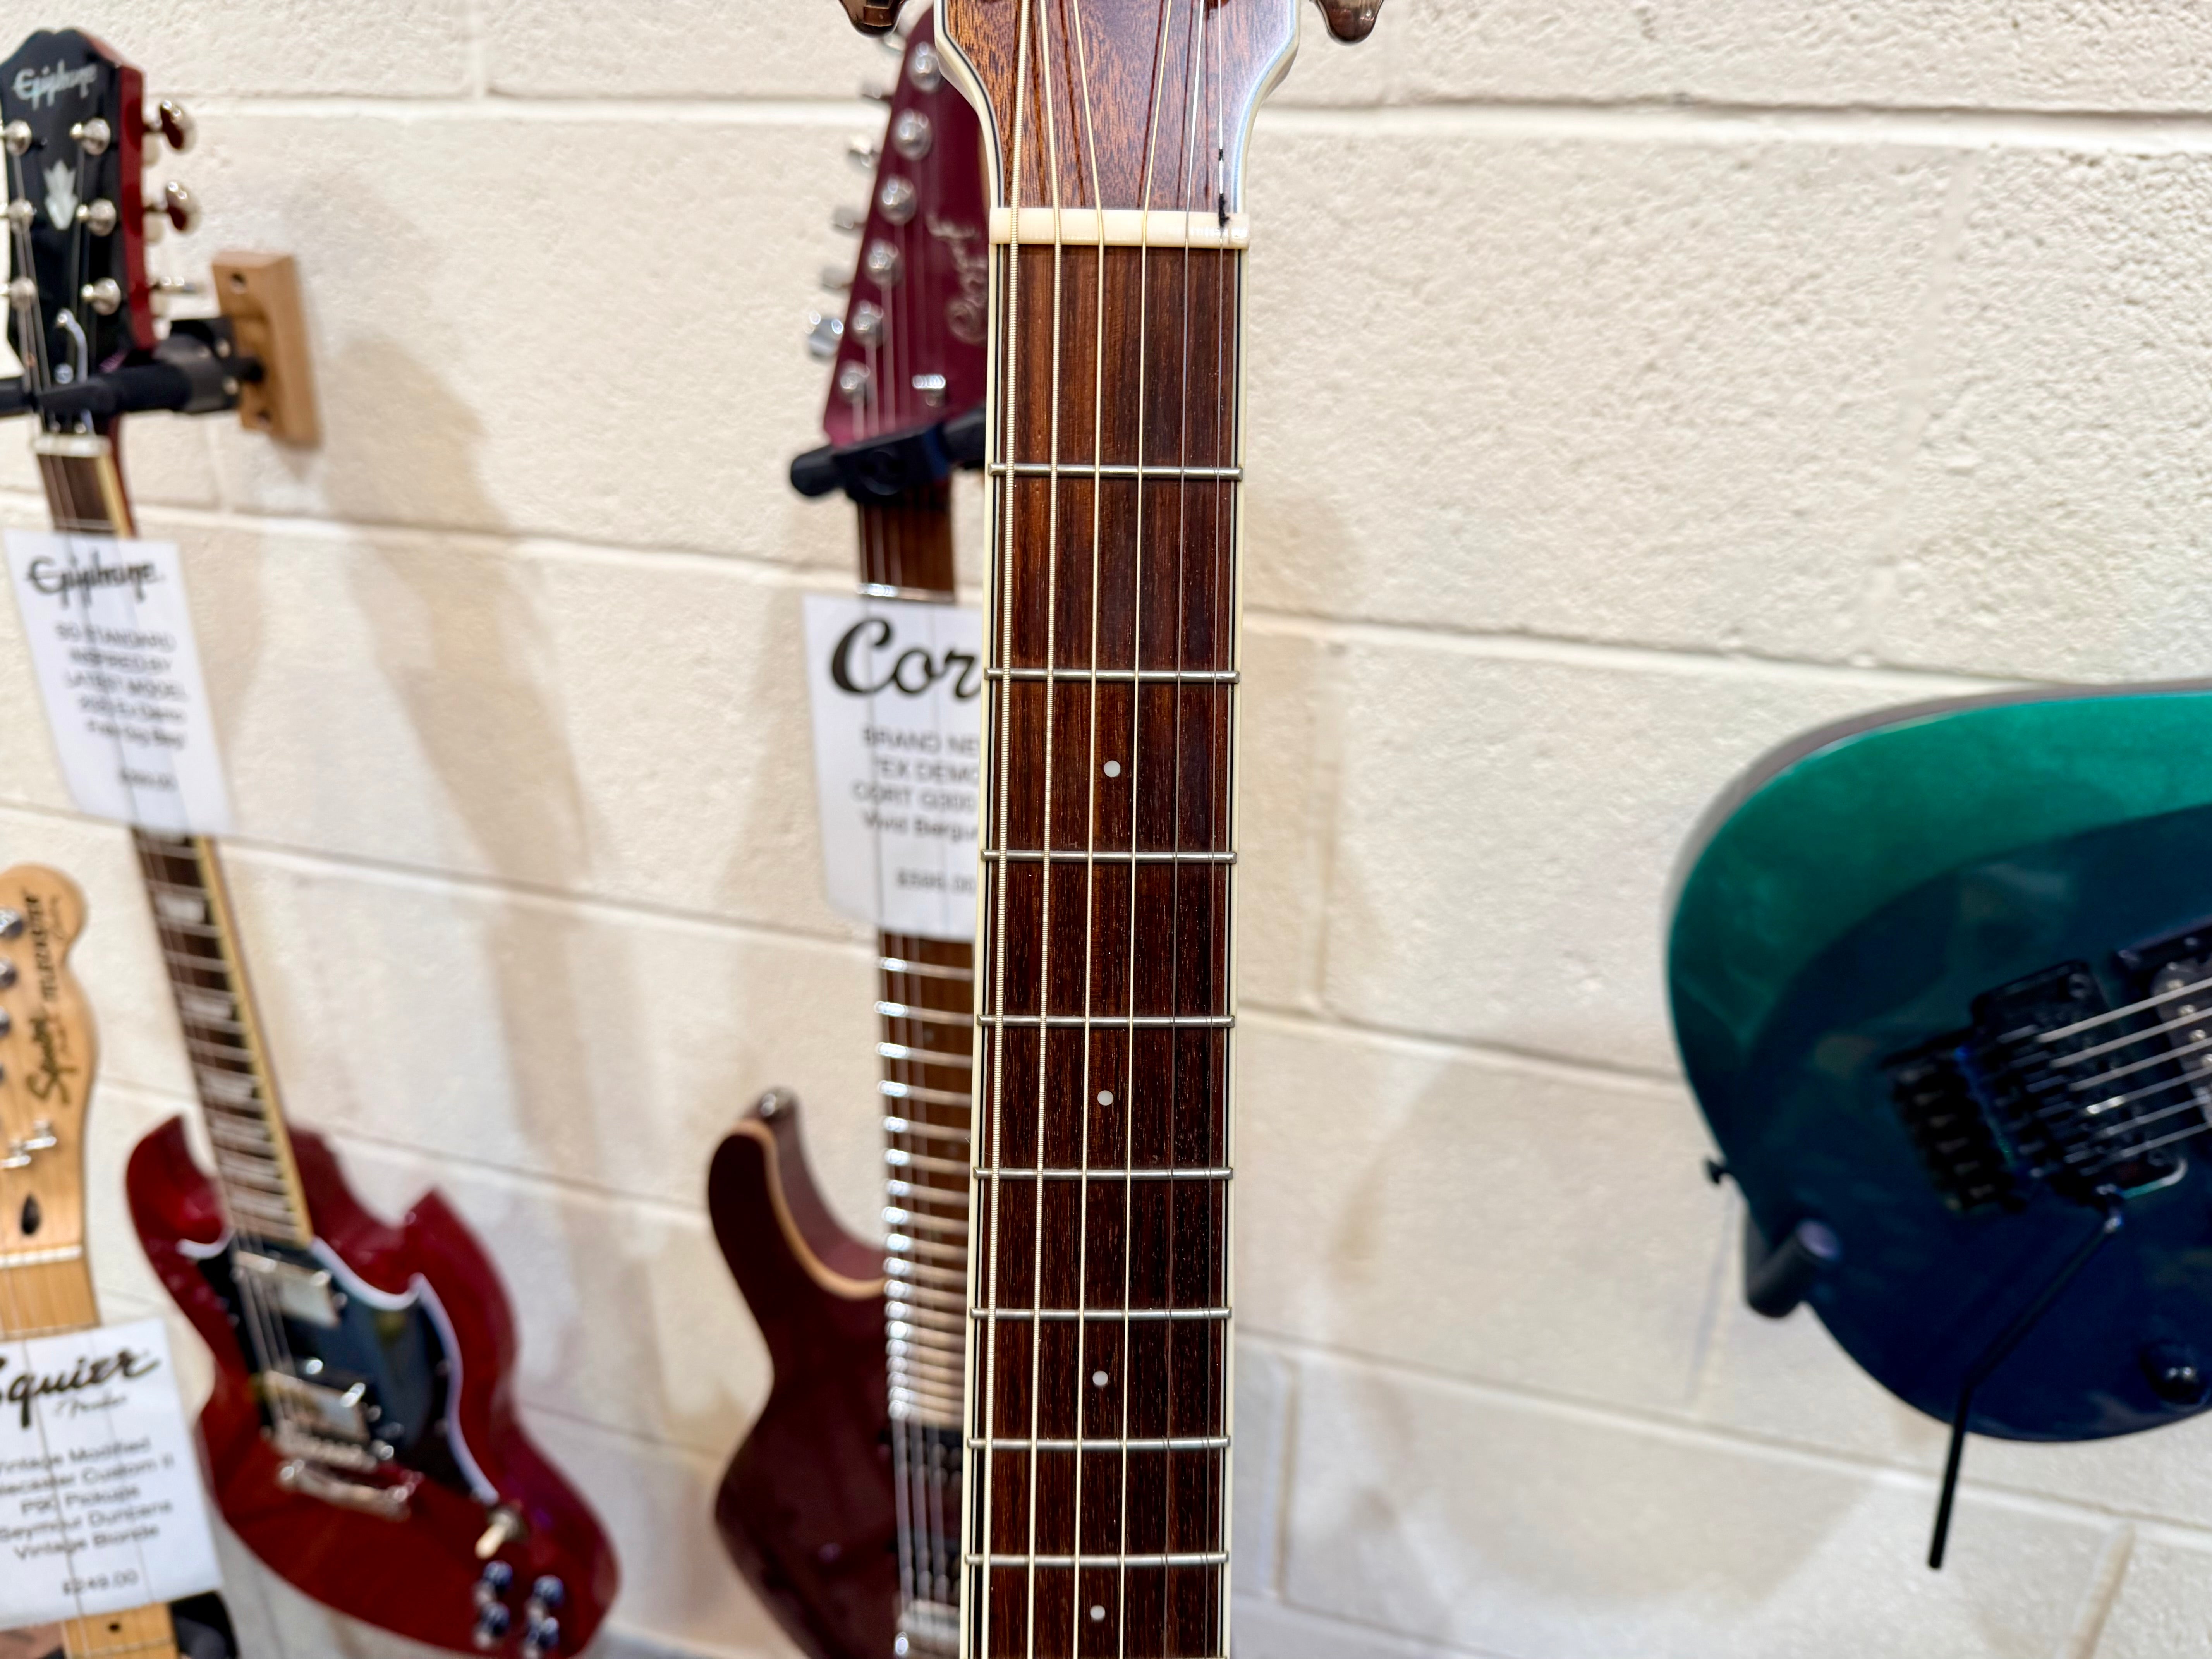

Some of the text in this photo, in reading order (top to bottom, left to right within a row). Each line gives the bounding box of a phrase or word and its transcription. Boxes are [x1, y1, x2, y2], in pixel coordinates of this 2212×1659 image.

[25, 548, 157, 608] Epiphone
[831, 618, 982, 700] Cor
[862, 726, 980, 756] BRAND NE
[0, 1350, 163, 1428] quier
[0, 1436, 151, 1471] intage Modified
[81, 1459, 157, 1484] Custom
[65, 1484, 140, 1506] Pickups
[14, 1537, 87, 1560] Vintage
